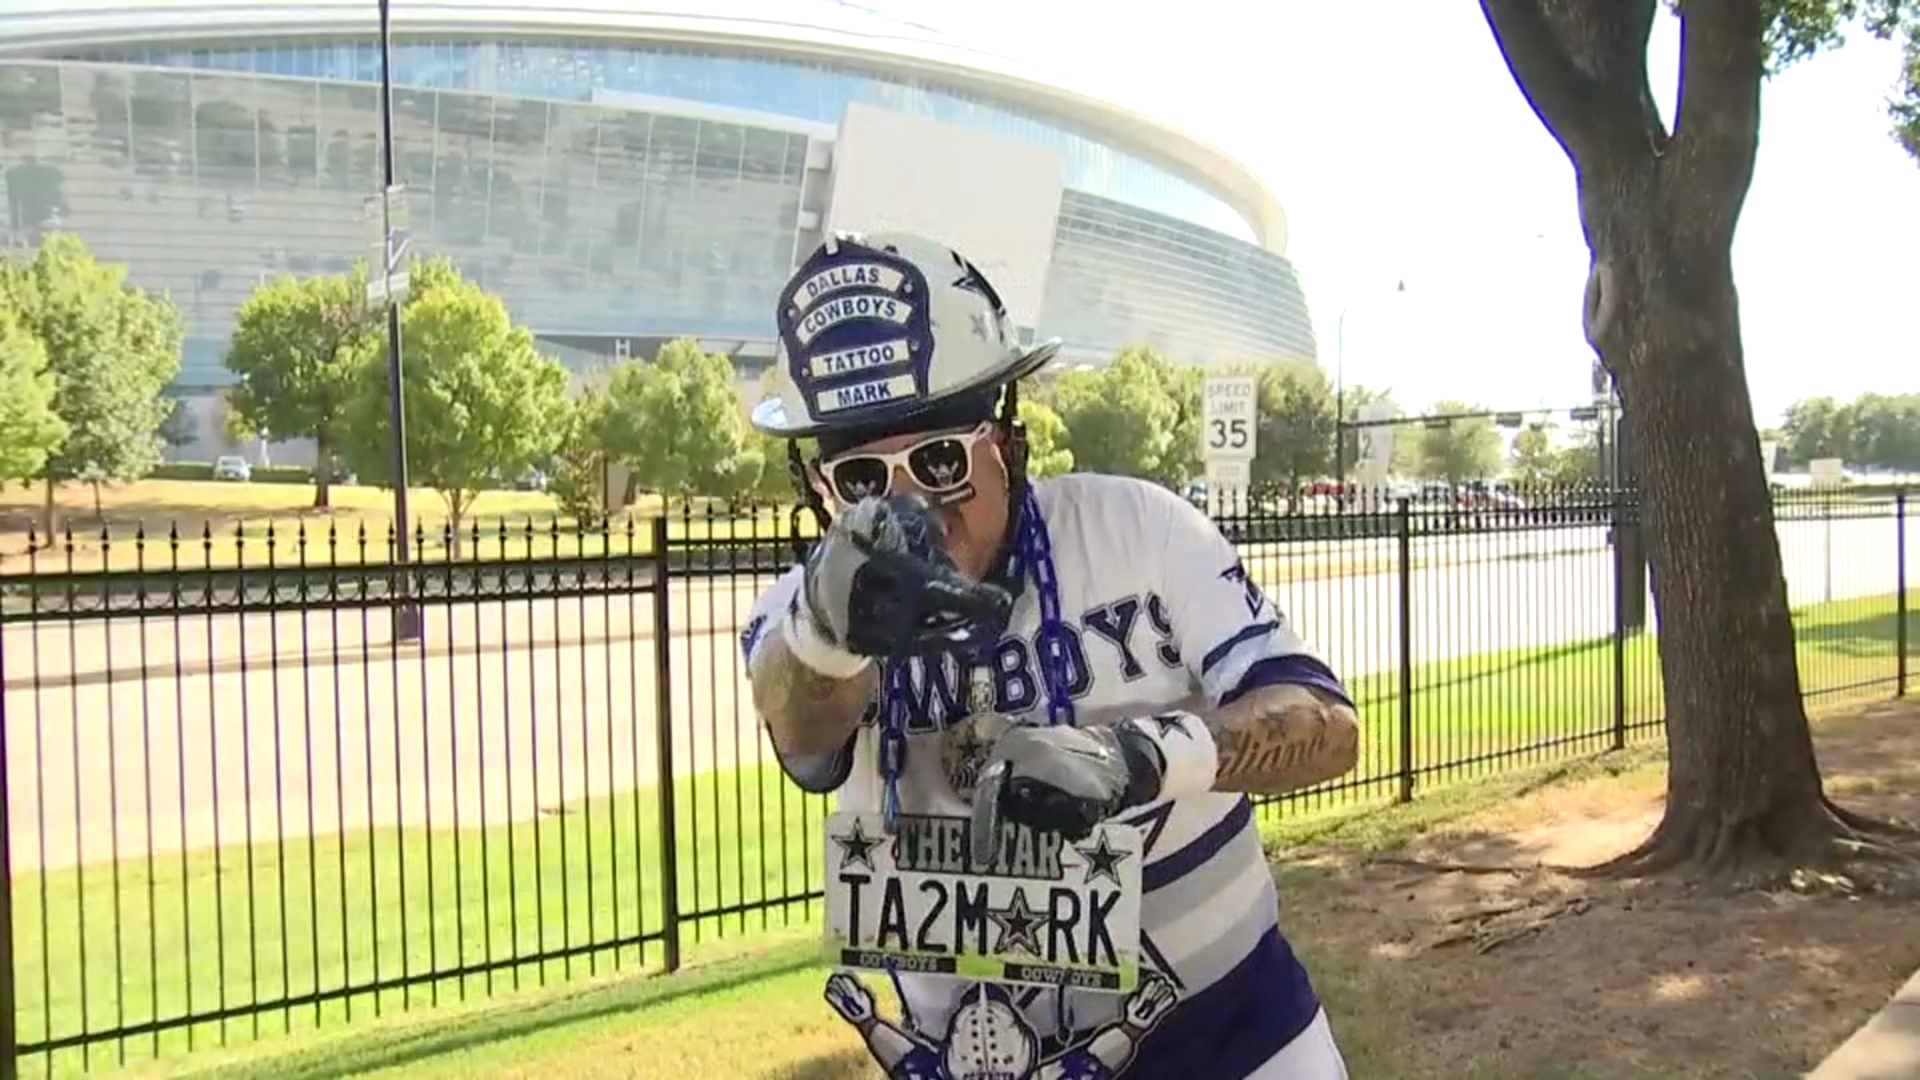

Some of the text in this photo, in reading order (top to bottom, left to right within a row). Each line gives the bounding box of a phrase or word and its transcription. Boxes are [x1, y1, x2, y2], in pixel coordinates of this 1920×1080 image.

[807, 265, 880, 298] DALLAS
[804, 297, 897, 334] COWBOYS
[823, 343, 895, 373] TATTOO
[837, 381, 893, 407] MARK
[1208, 383, 1250, 398] SPEED
[1209, 399, 1245, 416] LIMIT
[1210, 418, 1248, 449] 35
[859, 589, 1184, 735] WBOYS
[897, 816, 1063, 879] THE TAR
[1021, 966, 1102, 988] COWOYS
